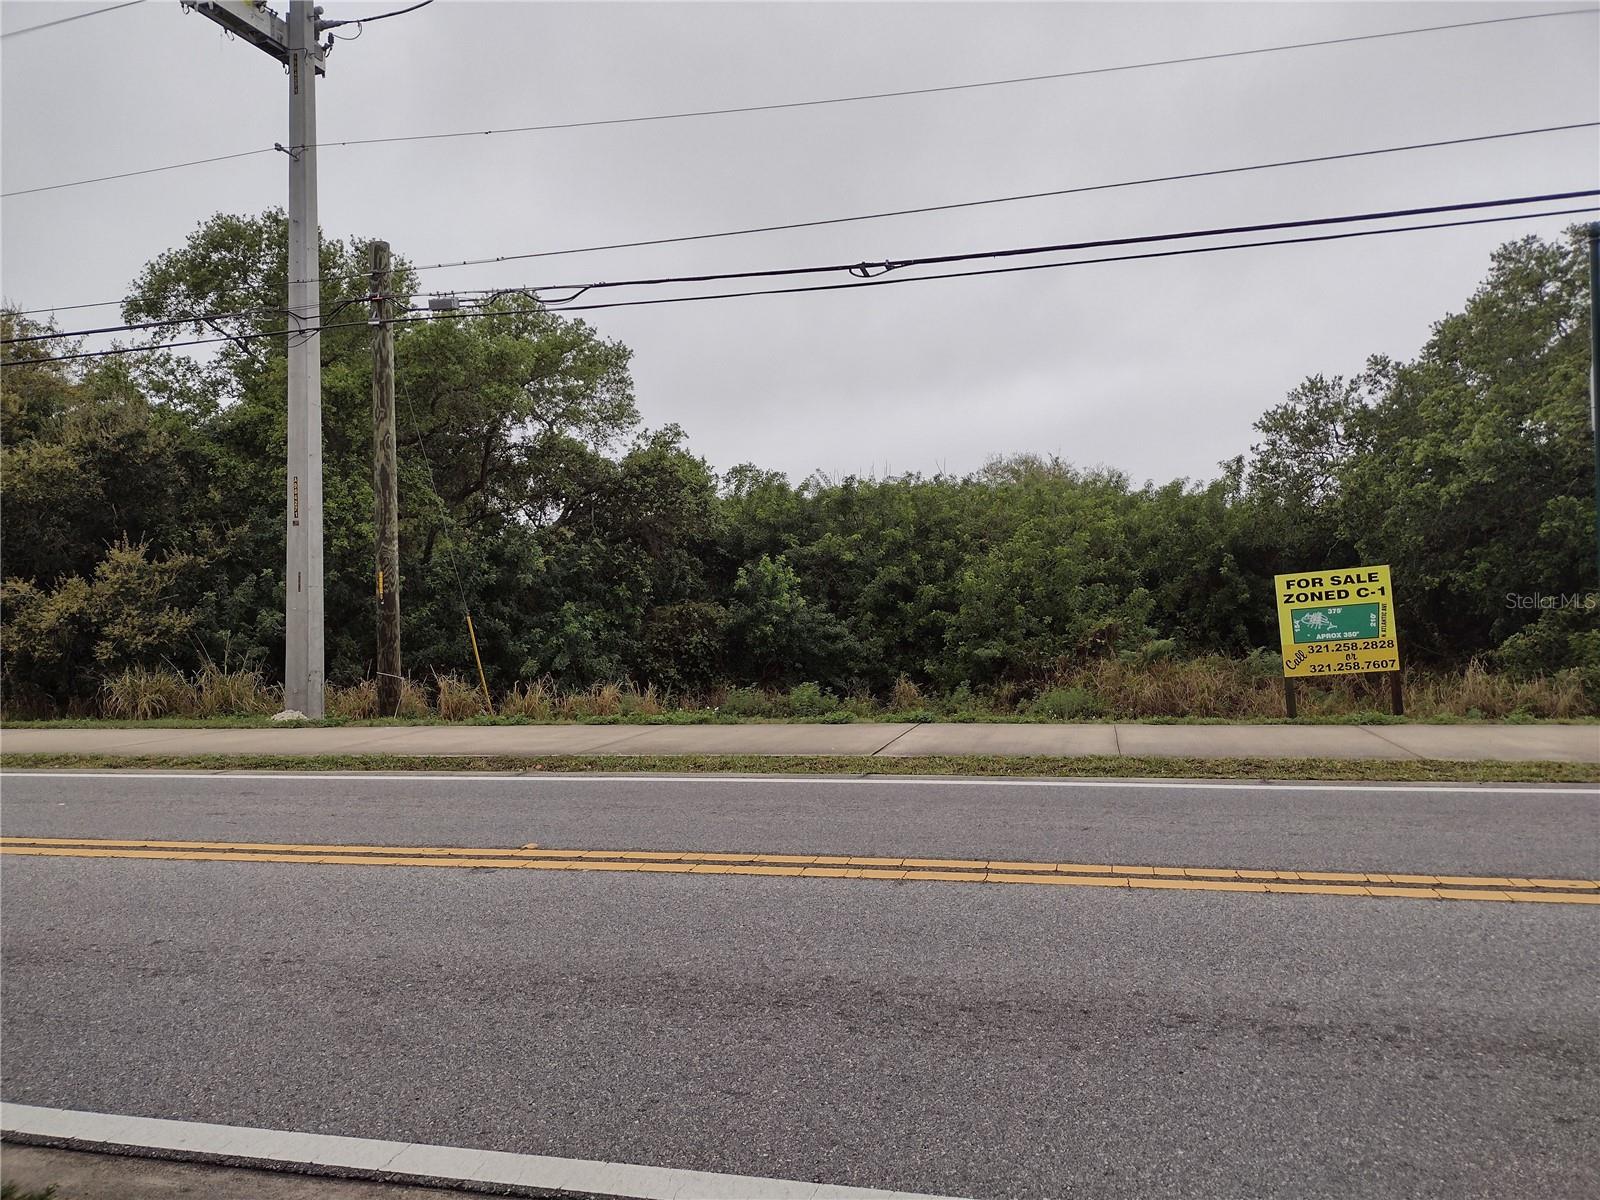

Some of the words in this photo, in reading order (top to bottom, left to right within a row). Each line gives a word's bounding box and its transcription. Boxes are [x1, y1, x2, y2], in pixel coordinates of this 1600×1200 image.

[1286, 577, 1323, 590] FOR
[1330, 572, 1379, 586] SALE
[1283, 589, 1349, 604] ZONED
[1356, 586, 1385, 597] C-1
[1316, 632, 1342, 640] APROX
[1307, 640, 1394, 654] 321.258.2828
[1285, 650, 1307, 670] Call
[1310, 659, 1396, 673] 321.258.7607
